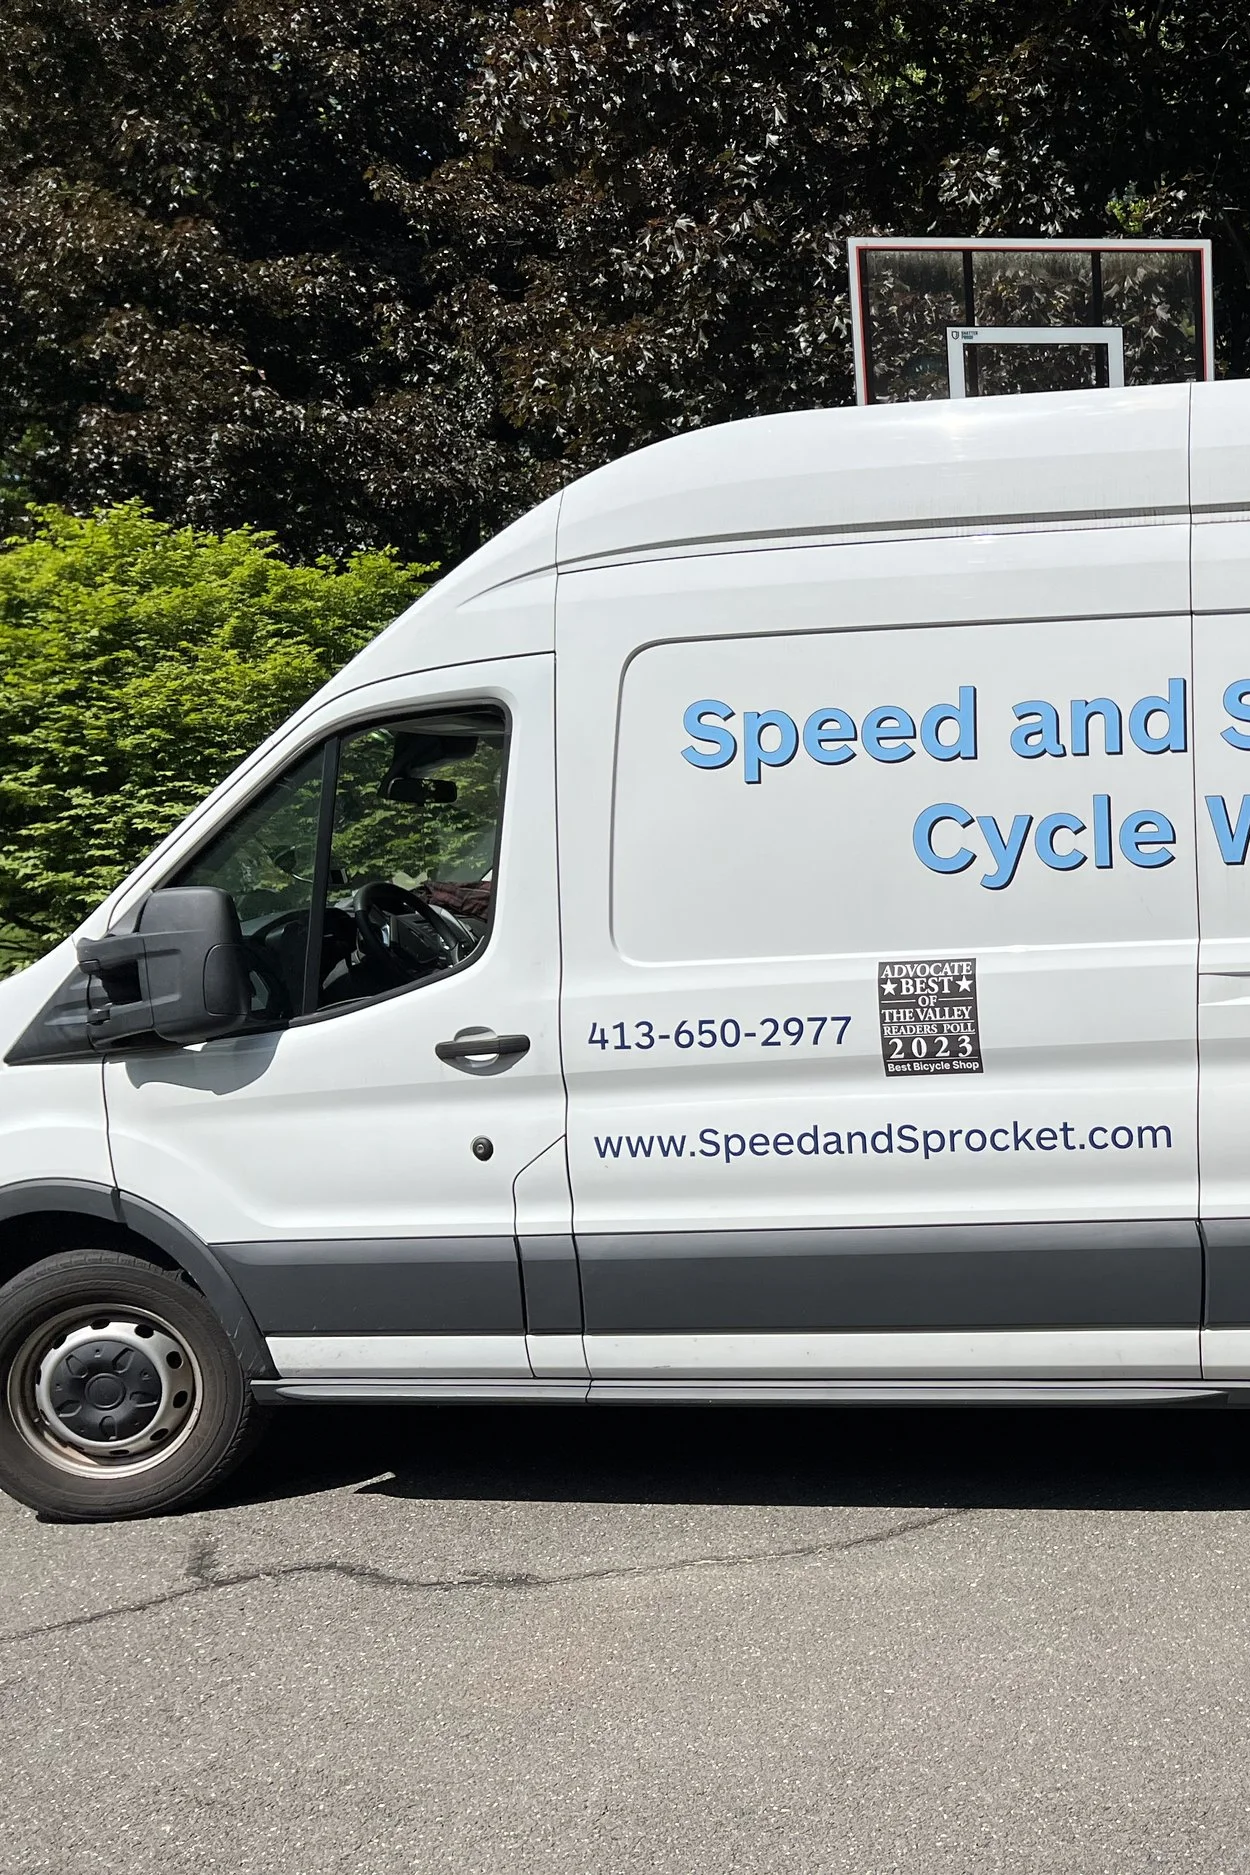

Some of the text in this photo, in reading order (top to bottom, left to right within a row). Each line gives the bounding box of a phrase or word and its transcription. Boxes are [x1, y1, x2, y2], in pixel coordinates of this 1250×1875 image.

[680, 685, 978, 785] Speed
[1010, 677, 1188, 760] and
[912, 793, 1177, 890] Cycle
[880, 961, 973, 979] ADVOCATE
[900, 976, 953, 995] BEST
[918, 995, 937, 1007] OF
[881, 1006, 973, 1022] THE VALLEY
[587, 1015, 852, 1051] 413-650-2977
[883, 1022, 976, 1035] READERS POLL
[888, 1035, 973, 1059] 2023
[887, 1060, 980, 1073] Best Bicycle Shop
[593, 1120, 1172, 1164] www.SpeedandSprocket.com
